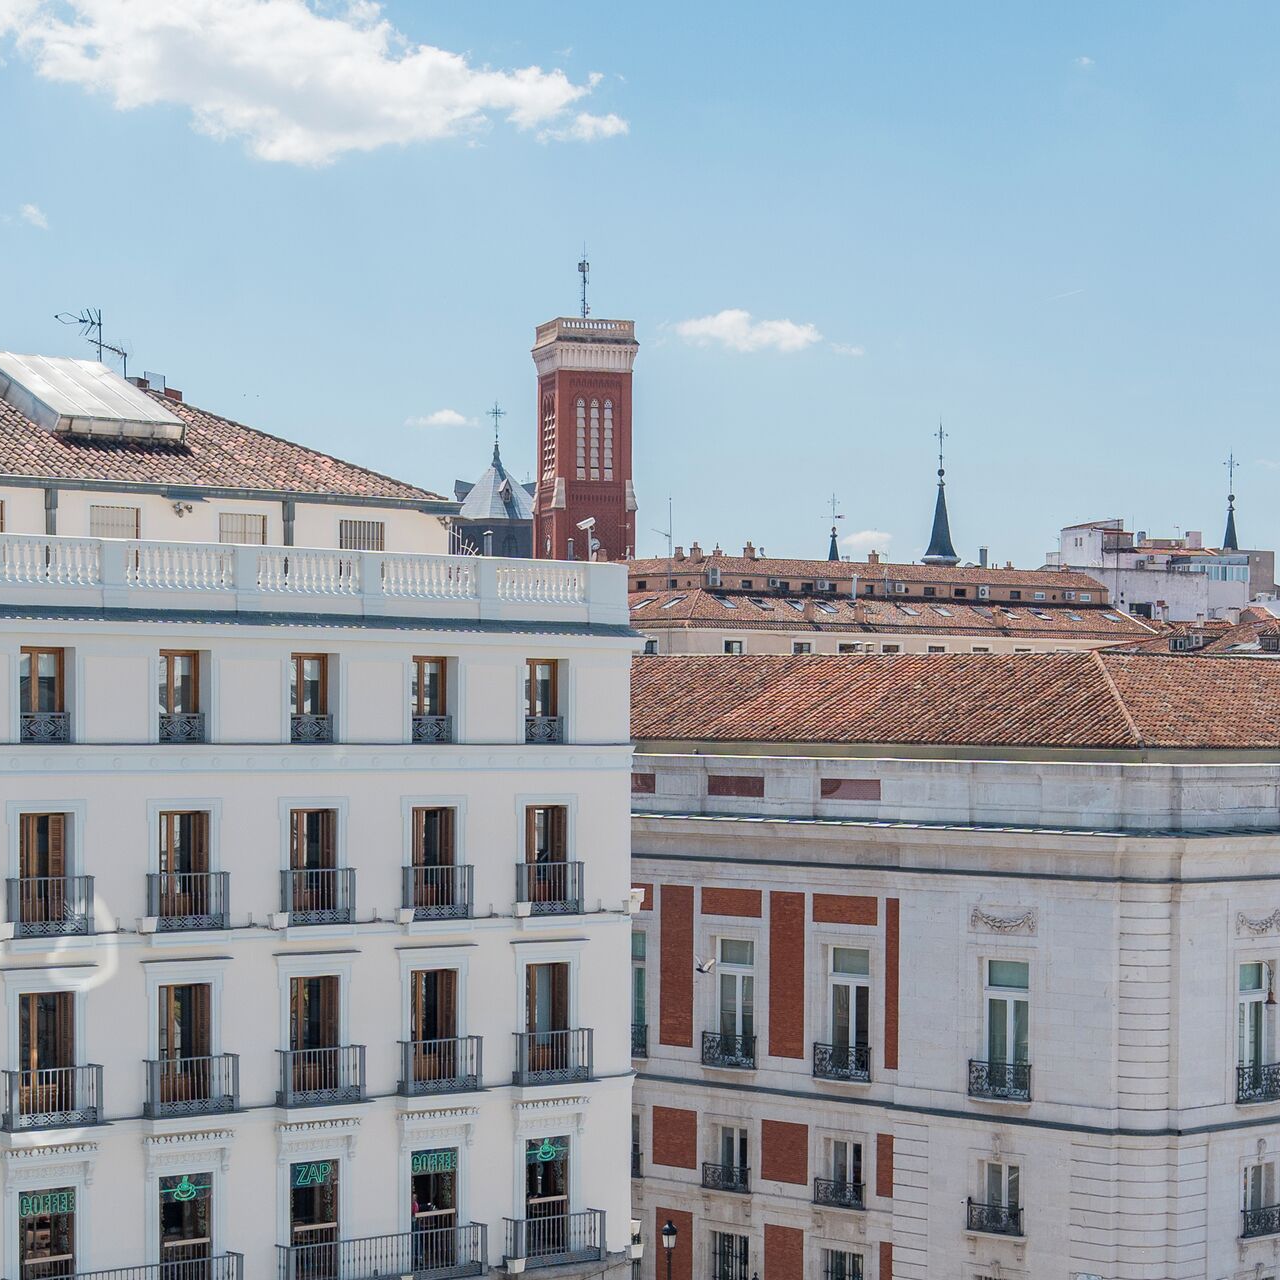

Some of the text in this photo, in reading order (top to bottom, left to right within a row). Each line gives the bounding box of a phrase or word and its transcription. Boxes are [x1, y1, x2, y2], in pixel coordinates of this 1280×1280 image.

[297, 1162, 331, 1186] ZAP
[411, 1152, 457, 1174] COFFEE
[19, 1192, 75, 1217] COFFEE
